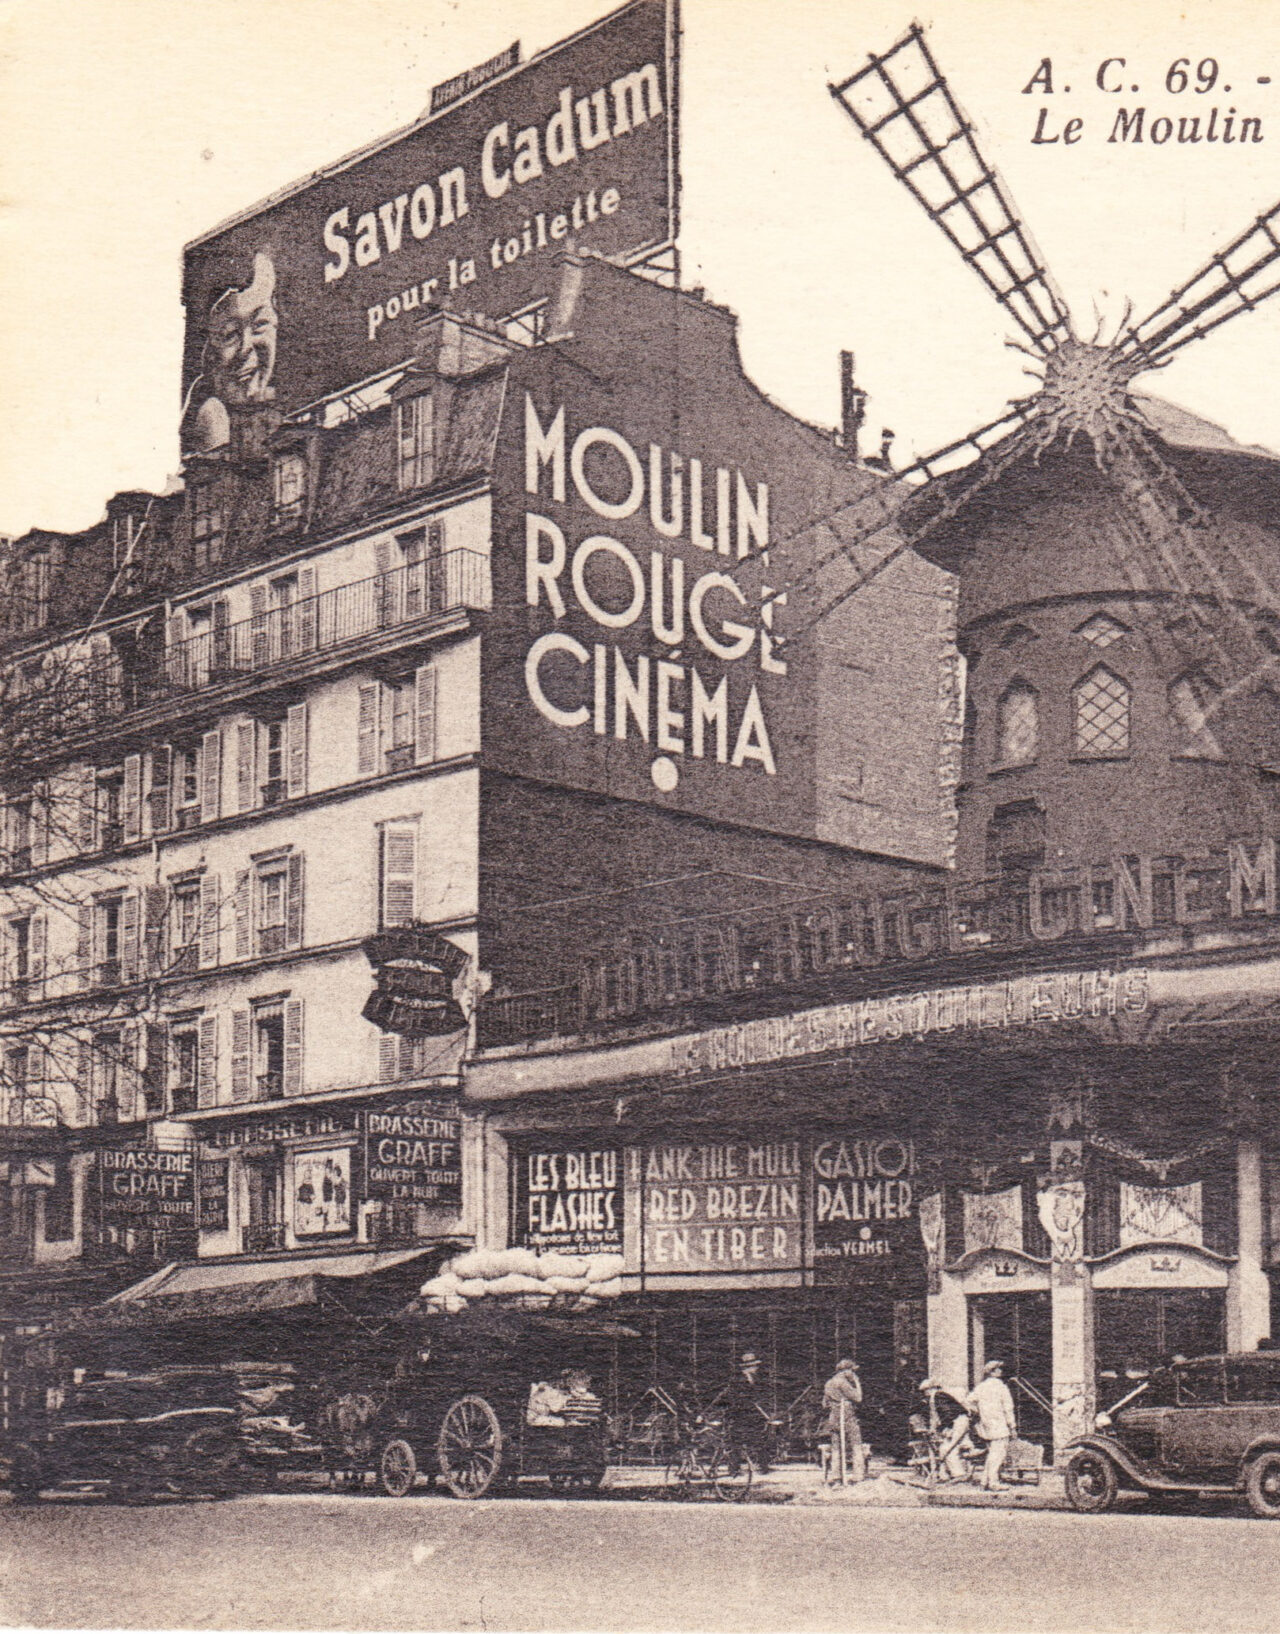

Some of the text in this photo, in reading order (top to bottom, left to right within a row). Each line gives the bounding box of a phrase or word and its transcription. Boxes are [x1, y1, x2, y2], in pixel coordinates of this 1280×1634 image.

[323, 165, 470, 284] Savon
[480, 62, 664, 199] Cadum
[367, 186, 622, 341] pour la toilette
[525, 390, 769, 567] MOULIN
[525, 511, 788, 676] ROUGE
[525, 632, 777, 775] CINÉMA
[368, 1113, 460, 1139] BRASSERIE
[102, 1150, 193, 1172] BRASSERIE
[378, 1138, 455, 1167] GRAFF
[528, 1150, 617, 1193] LES BLEU
[698, 1145, 739, 1180] THE
[112, 1172, 188, 1198] GRAFF
[705, 1183, 798, 1219] BREZIN
[817, 1180, 913, 1222] PALMER
[528, 1191, 616, 1234] FLASHES
